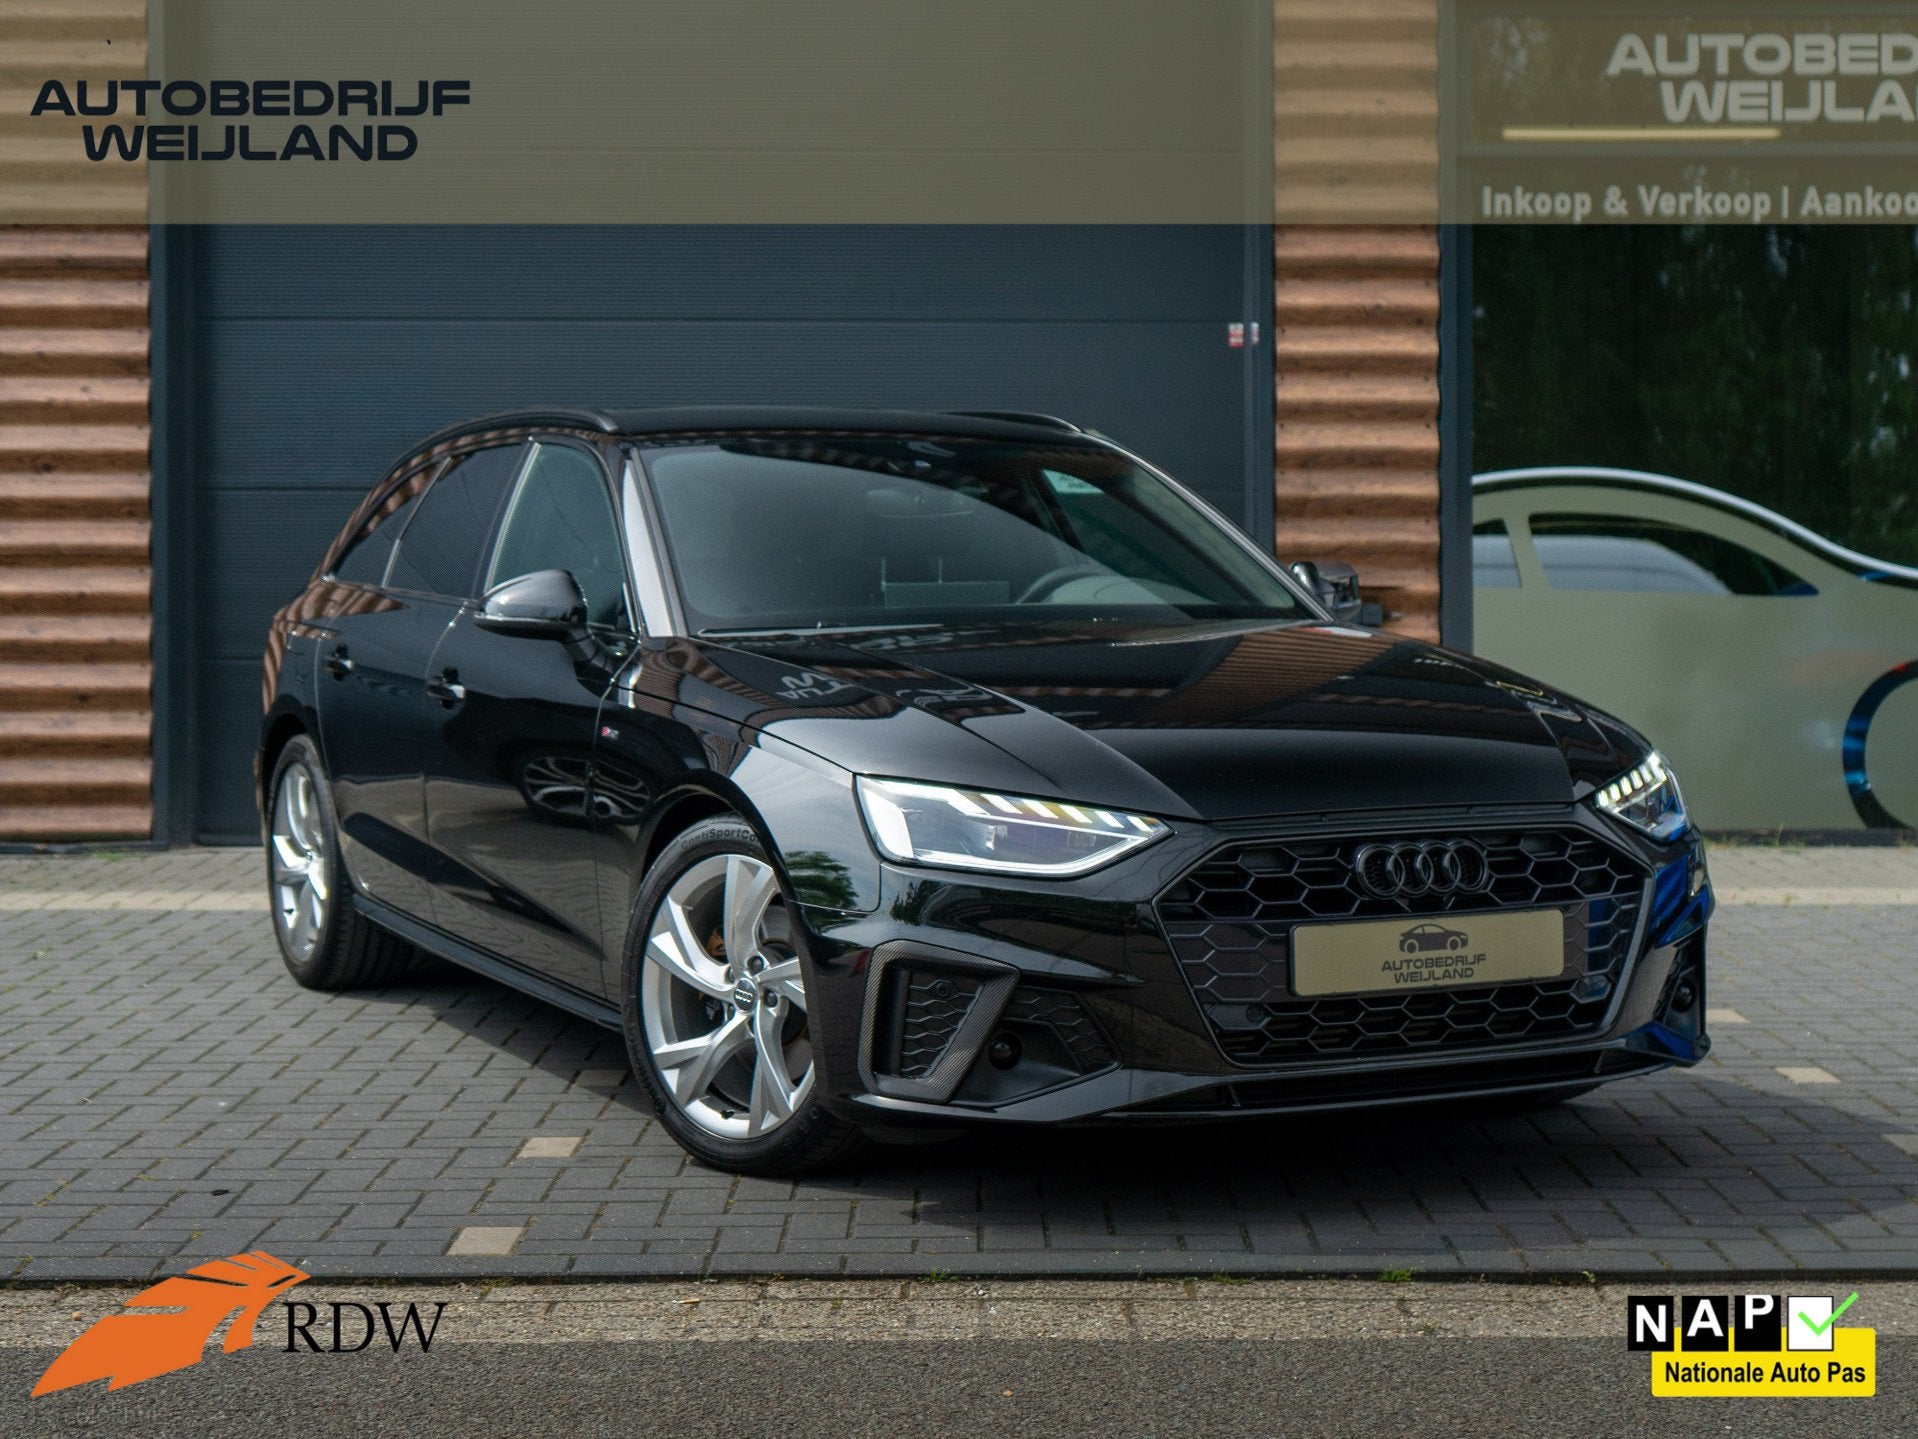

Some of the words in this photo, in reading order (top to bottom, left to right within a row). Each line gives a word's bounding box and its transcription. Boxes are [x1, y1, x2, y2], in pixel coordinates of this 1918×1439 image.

[1606, 33, 1918, 75] AUTOBED
[1659, 79, 1918, 123] WEIJLA
[1482, 185, 1593, 223] Inkoop
[1604, 185, 1628, 217] &
[1637, 185, 1771, 223] Verkoop
[1800, 184, 1918, 218] Aankoo
[1381, 953, 1487, 972] AUTOBEDRIJF
[1394, 967, 1475, 984] WEIJLAND
